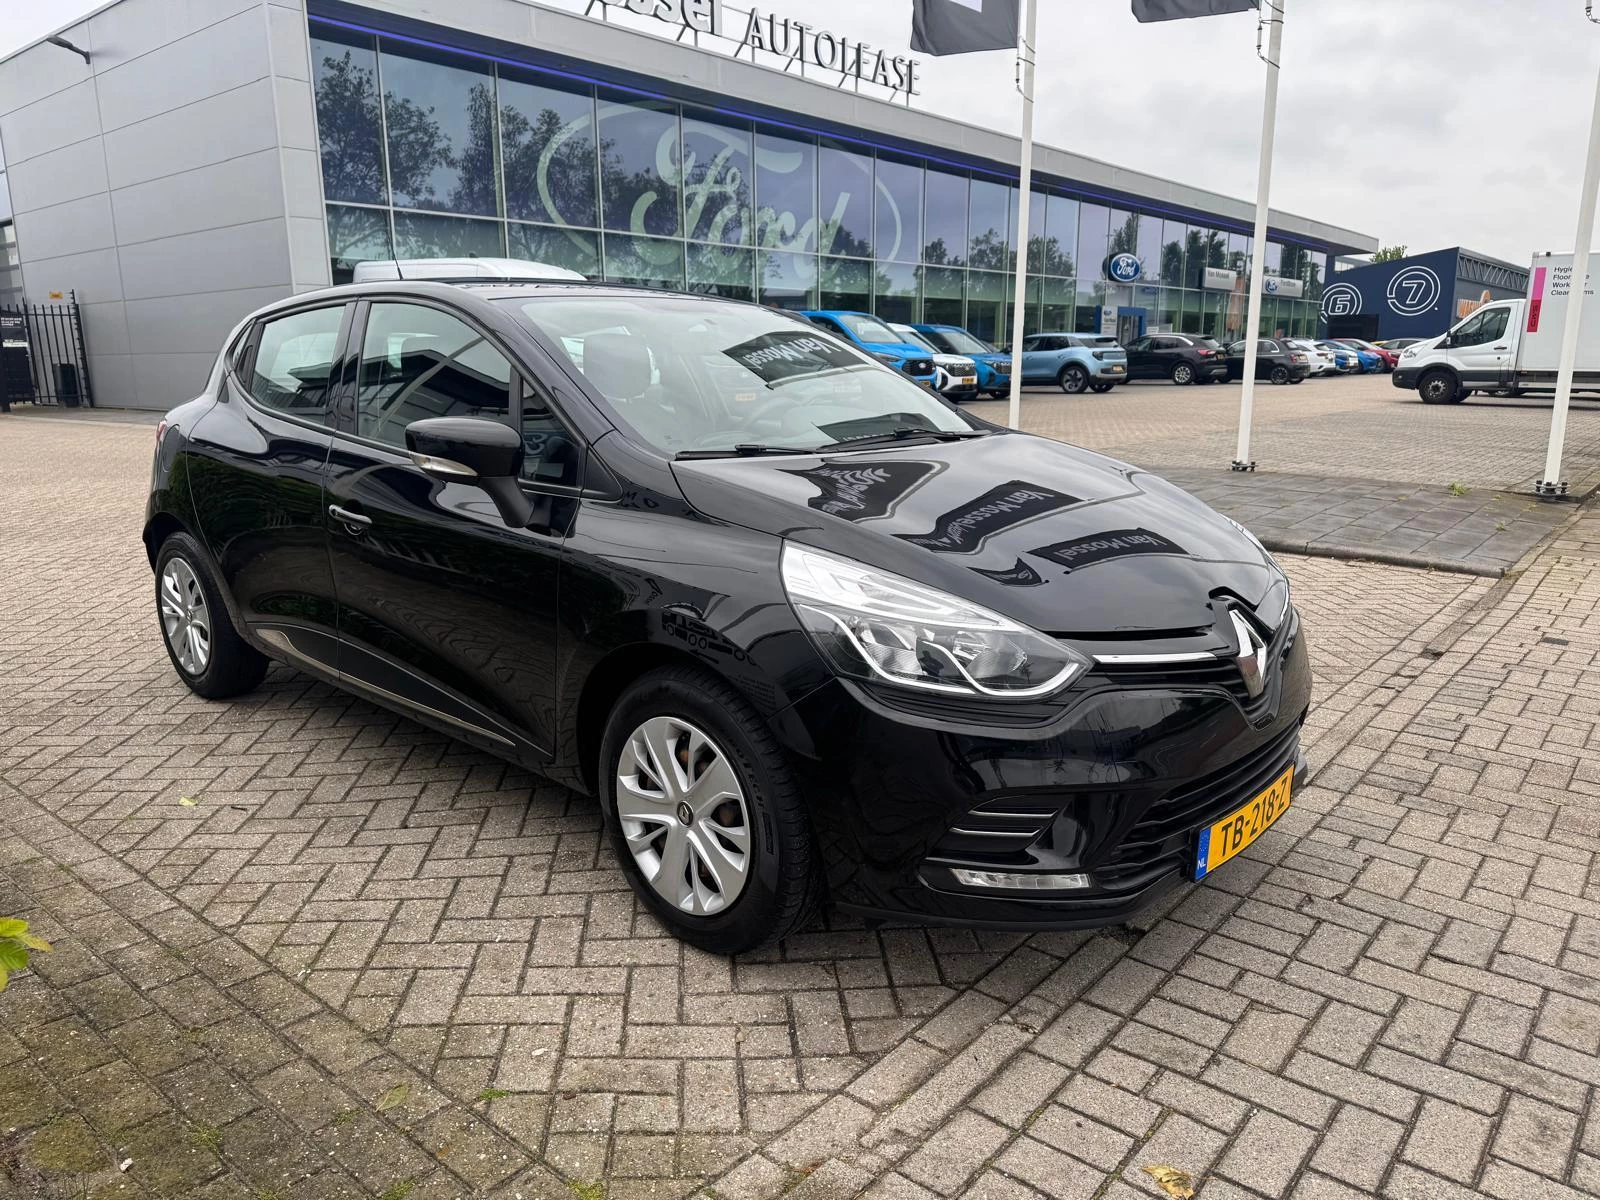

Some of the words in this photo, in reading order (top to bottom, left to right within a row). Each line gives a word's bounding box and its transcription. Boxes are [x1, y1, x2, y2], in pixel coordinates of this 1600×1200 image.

[744, 7, 921, 95] AUTOLEASE
[630, 122, 851, 281] Ford
[1116, 257, 1136, 276] Ford
[1402, 280, 1426, 305] 7
[1327, 294, 1351, 316] 6
[743, 341, 803, 370] Mossel
[794, 337, 842, 355] Van
[1005, 489, 1055, 504] Van
[1053, 538, 1123, 561] Mossel
[1122, 534, 1168, 547] Van
[1221, 776, 1288, 857] TB-218-Z
[1197, 857, 1206, 870] NL
